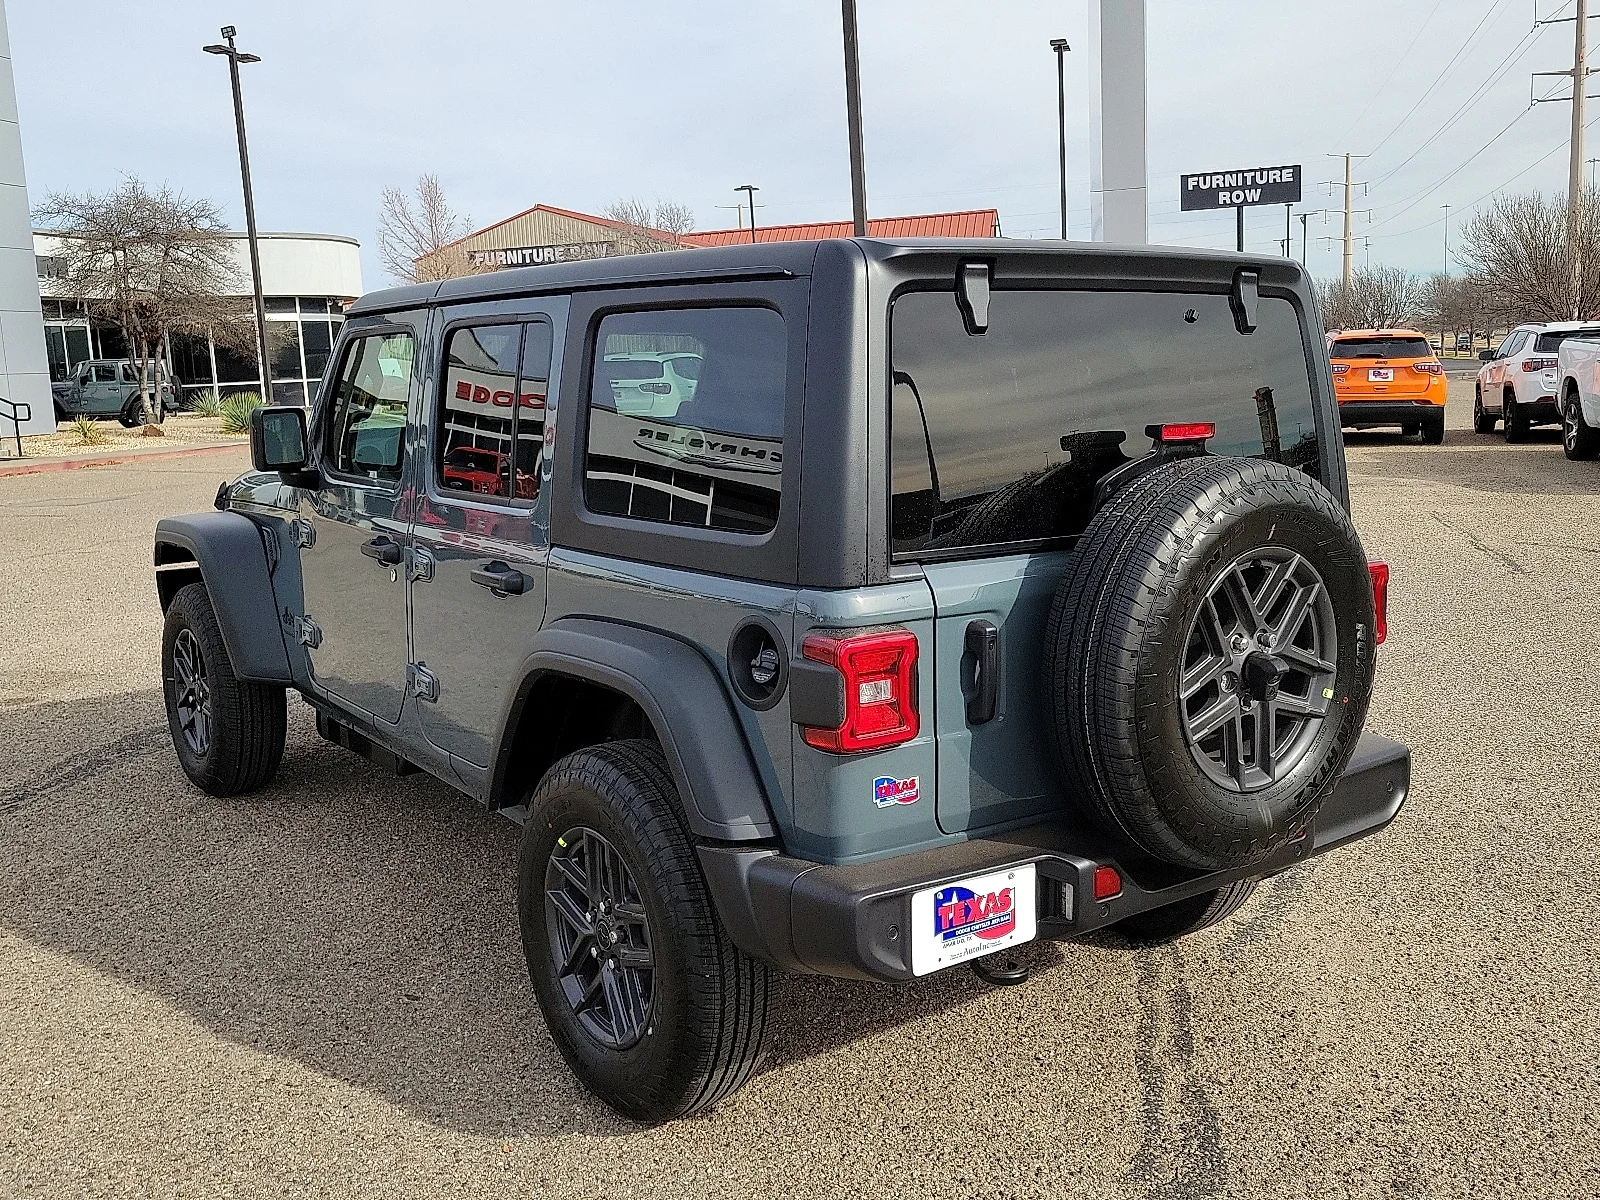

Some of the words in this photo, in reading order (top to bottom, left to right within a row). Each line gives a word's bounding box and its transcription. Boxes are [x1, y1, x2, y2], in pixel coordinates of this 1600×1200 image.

[1187, 169, 1293, 190] FURNITURE
[1218, 188, 1261, 205] ROW
[475, 246, 565, 267] FURNITURE
[938, 887, 1012, 930] TEXAS
